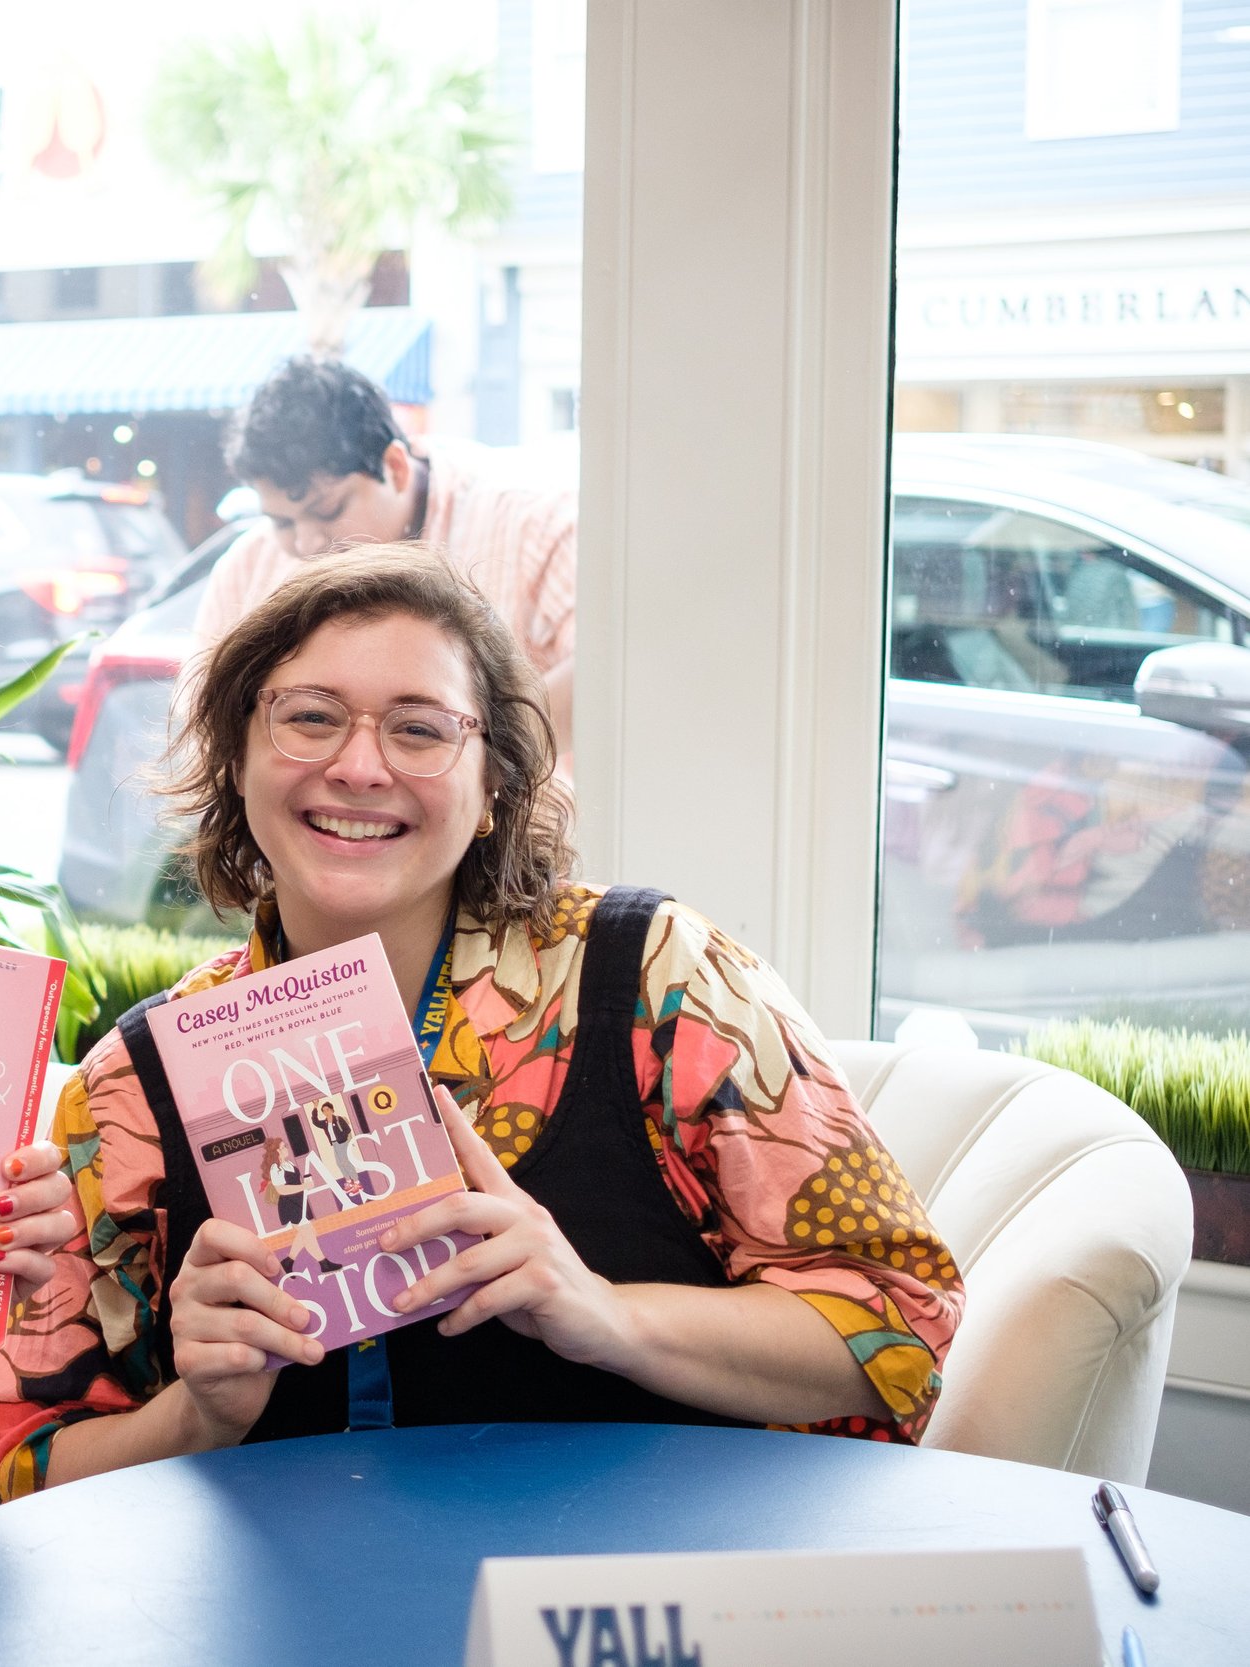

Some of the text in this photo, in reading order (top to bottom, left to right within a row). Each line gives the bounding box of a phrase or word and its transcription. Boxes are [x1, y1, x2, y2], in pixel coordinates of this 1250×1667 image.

[176, 958, 367, 1033] Casey McQuiston
[192, 985, 369, 1049] NEW YORK TIMES BESTSELLING AUTHOR OF
[224, 1040, 245, 1052] RED,
[247, 1029, 275, 1043] WHITE
[288, 1016, 317, 1030] ROYAL
[320, 1006, 343, 1019] BLUE
[222, 1020, 381, 1124] ONE
[374, 1091, 392, 1109] Q
[212, 1132, 259, 1156] A NOVEL
[236, 1113, 434, 1239] LAST
[343, 1238, 377, 1255] stops you
[355, 1220, 396, 1238] Sometimes
[278, 1234, 457, 1339] STOP
[538, 1599, 704, 1667] YALL
